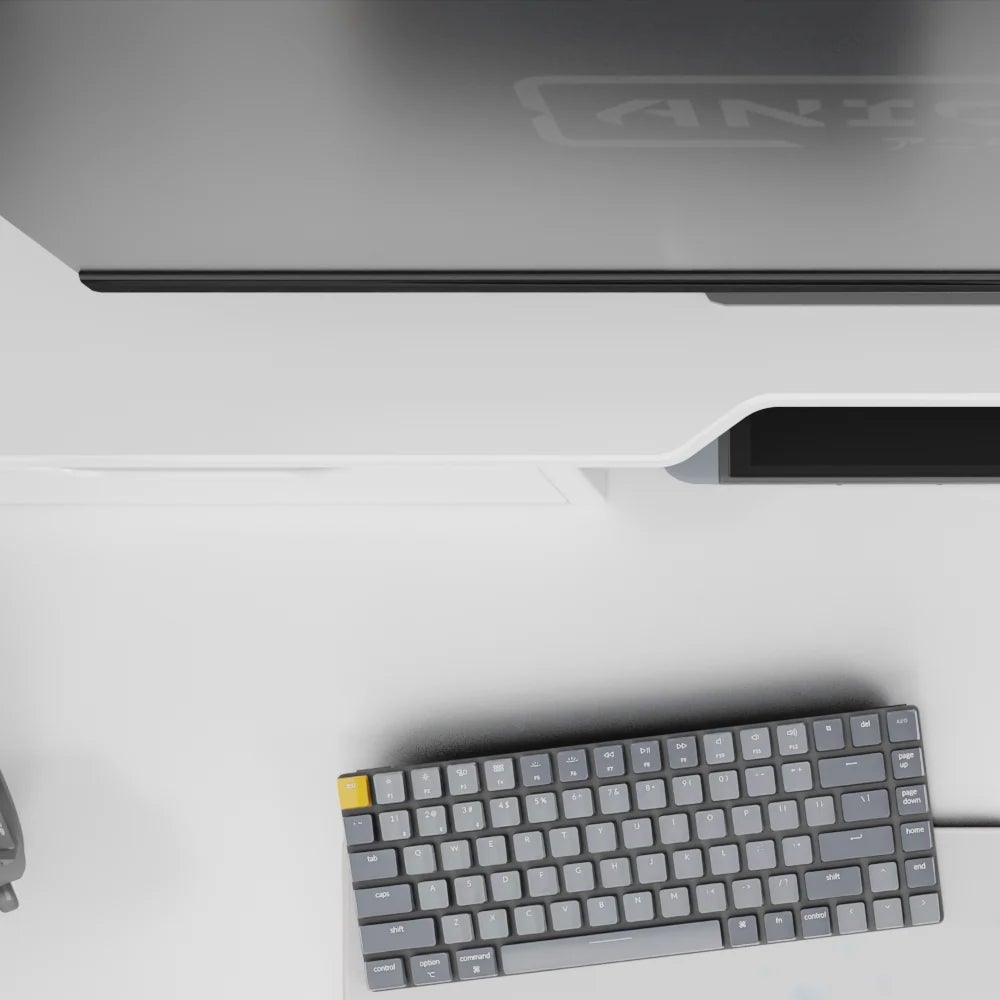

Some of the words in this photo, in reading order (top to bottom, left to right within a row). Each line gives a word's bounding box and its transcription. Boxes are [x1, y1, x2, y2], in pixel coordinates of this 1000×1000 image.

[860, 720, 871, 728] del
[898, 751, 915, 760] page
[899, 761, 909, 769] up
[901, 789, 918, 797] page
[902, 796, 922, 805] down
[906, 826, 925, 835] home
[450, 845, 459, 853] W
[367, 854, 379, 863] tab
[913, 862, 926, 871] end
[825, 872, 841, 881] shift
[374, 890, 390, 899] caps
[804, 911, 827, 921] control
[389, 925, 405, 934] shift
[459, 952, 491, 961] command
[373, 963, 396, 973] control
[419, 959, 441, 968] option
